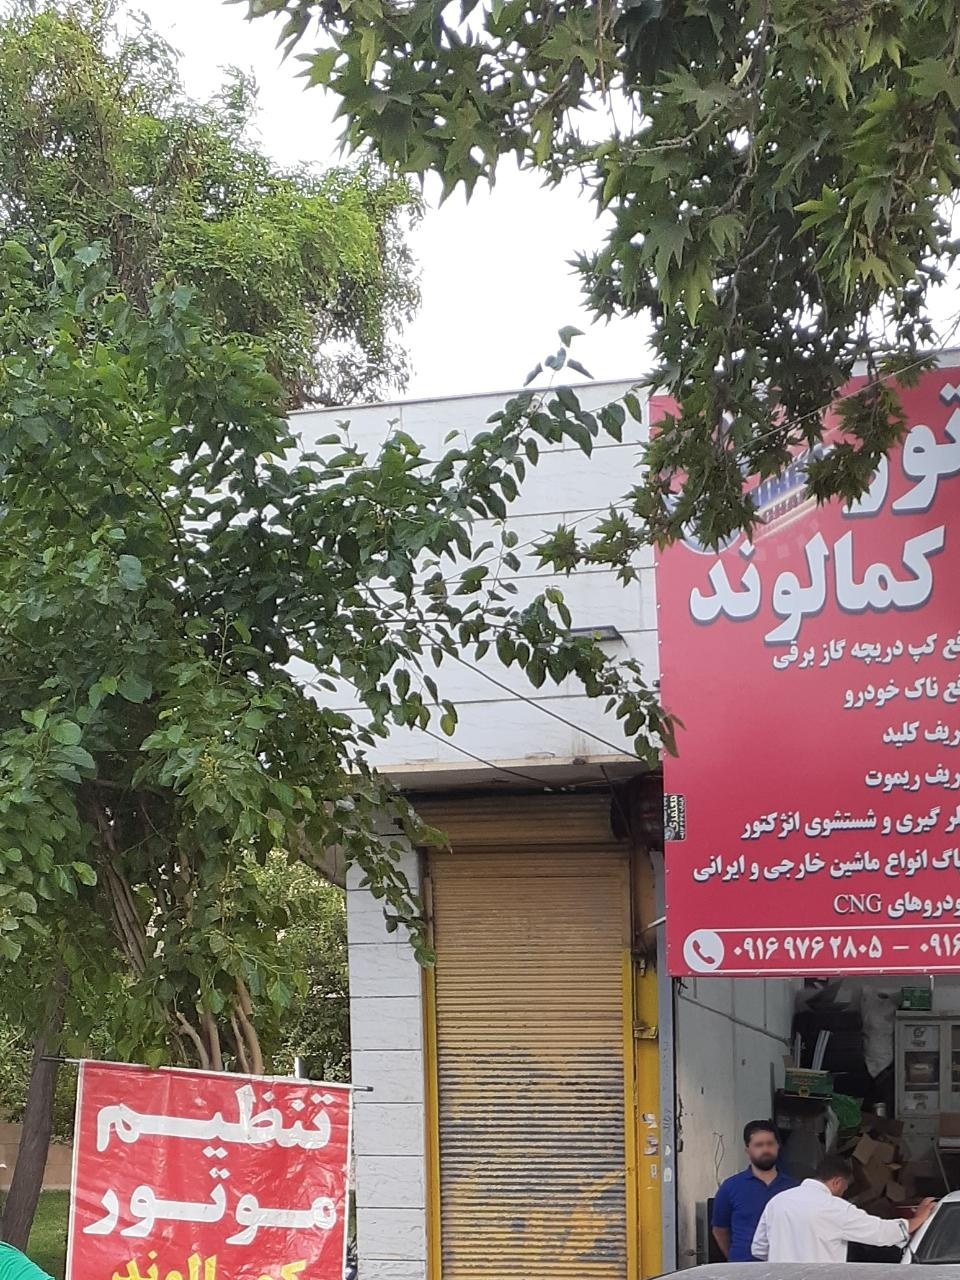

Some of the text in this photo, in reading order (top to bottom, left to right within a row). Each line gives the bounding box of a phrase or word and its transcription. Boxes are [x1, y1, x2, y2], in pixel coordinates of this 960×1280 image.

[689, 527, 944, 645] کمالوند
[772, 641, 815, 669] برقی
[819, 638, 846, 667] گاز
[851, 639, 904, 664] دریچه
[907, 633, 937, 662] کپ
[843, 679, 900, 708] خودرو
[904, 676, 938, 699] ناک
[882, 720, 920, 747] کلید
[865, 769, 921, 792] ریموت
[740, 810, 801, 840] انژکتور
[804, 808, 877, 837] شستشوی
[881, 815, 891, 834] و
[895, 805, 940, 834] گیری
[693, 854, 745, 882] ایرانی
[749, 861, 759, 880] و
[763, 852, 826, 880] خارجی
[830, 850, 880, 878] ماشین
[884, 849, 928, 876] انواع
[833, 893, 883, 914] CNG
[733, 936, 779, 960] ۰۹۱۶
[783, 935, 825, 959] ۹۷۶
[829, 934, 883, 959] ۲۸۰۵
[96, 1084, 334, 1159] تنظیم
[82, 1167, 338, 1246] موتور
